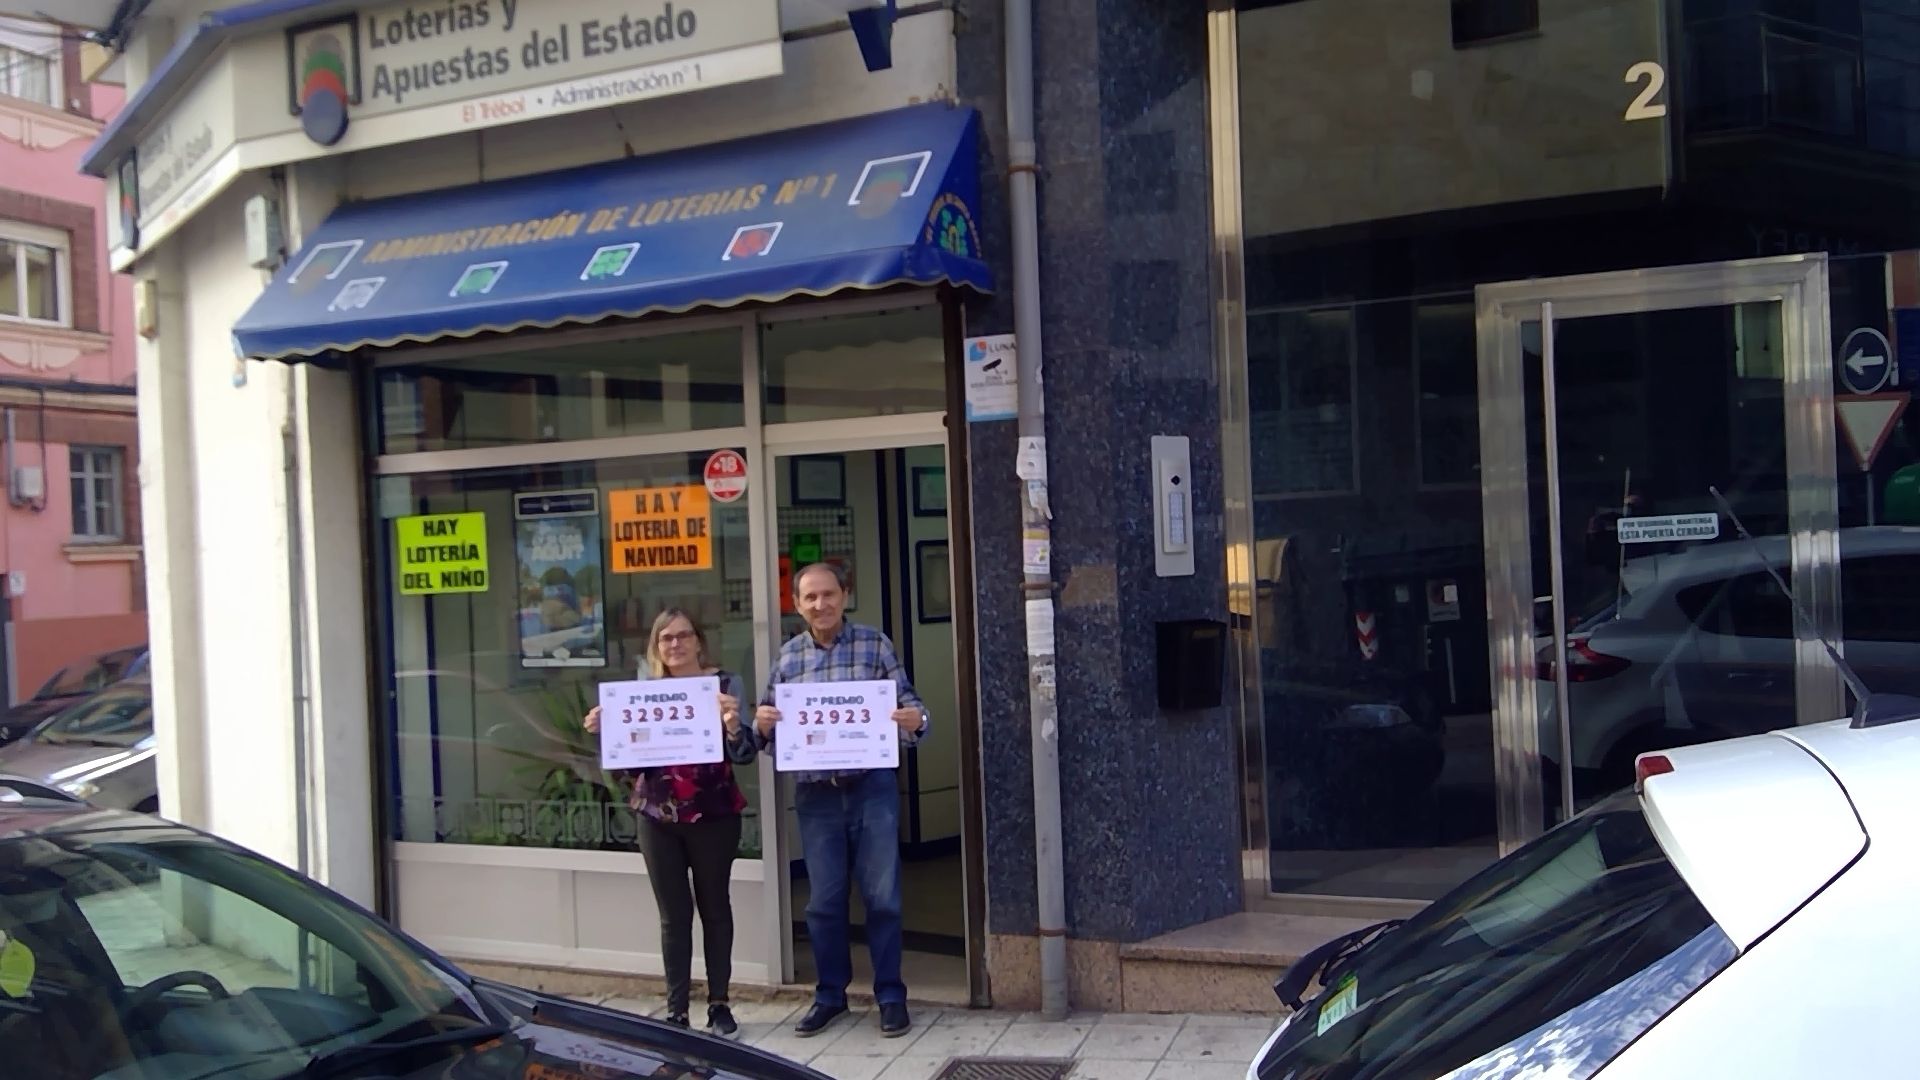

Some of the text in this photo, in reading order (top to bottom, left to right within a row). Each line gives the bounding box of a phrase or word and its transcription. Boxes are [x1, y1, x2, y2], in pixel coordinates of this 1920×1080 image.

[502, 0, 517, 31] y
[372, 2, 697, 103] Apuestas del Estado
[462, 104, 475, 122] El
[551, 74, 669, 107] Administración
[694, 63, 703, 81] 1
[1624, 61, 1667, 121] 2
[363, 209, 587, 264] ADMINISTRACIÓN
[586, 206, 628, 234] DE
[628, 183, 768, 228] LOTERIAS
[820, 171, 838, 198] 1
[636, 491, 682, 514] HAY
[423, 519, 459, 537] HAY
[614, 516, 706, 542] LOTERIA DE
[1619, 526, 1716, 540] ESTA PUERTA CERRADA
[406, 540, 480, 564] LOTERÍA
[624, 544, 698, 568] NAVIDAD
[403, 566, 485, 590] DEL NIÑO
[820, 695, 865, 706] PREMIO
[622, 705, 695, 724] 32923
[798, 709, 871, 725] 32923
